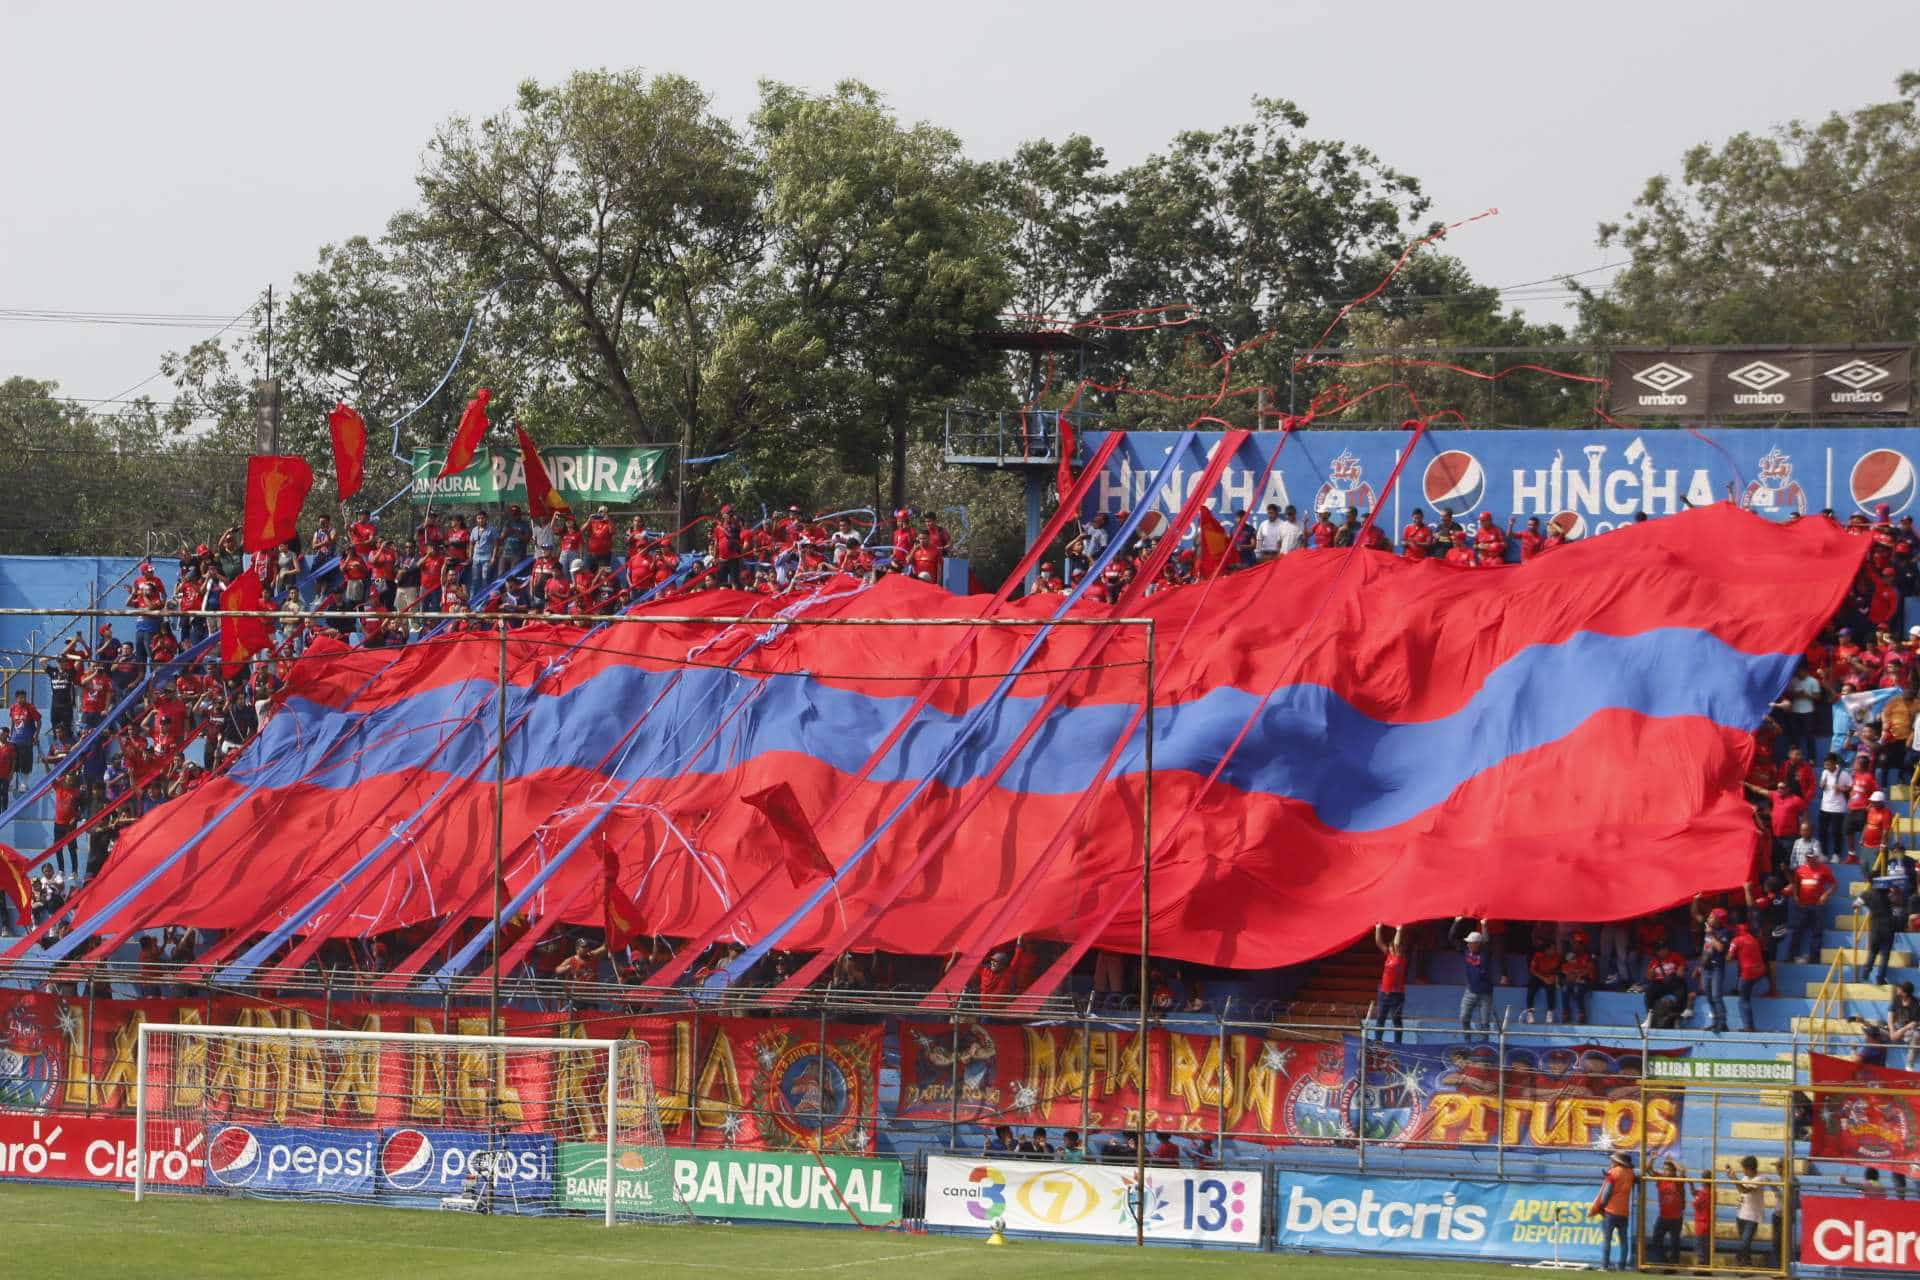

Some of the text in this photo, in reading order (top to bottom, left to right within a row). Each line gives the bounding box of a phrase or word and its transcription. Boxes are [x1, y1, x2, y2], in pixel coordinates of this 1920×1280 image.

[1638, 392, 1687, 406] umbro
[1734, 392, 1785, 405] umbro
[1831, 390, 1883, 403] umbro
[411, 475, 481, 494] ANRURAL
[1511, 450, 1714, 515] HINCHA
[1023, 1027, 1278, 1134] MAFIA ROJA
[1648, 1060, 1793, 1080] SALIDA DE EMERGENCIA
[1429, 1092, 1678, 1148] PITUFOS
[266, 1140, 374, 1184] pepsi
[673, 1158, 894, 1214] BANRURAL
[943, 1165, 1007, 1221] canal 3
[1043, 1180, 1073, 1224] 7
[1183, 1178, 1228, 1232] 13
[1285, 1185, 1488, 1242] betcris
[1509, 1199, 1605, 1224] APUEST
